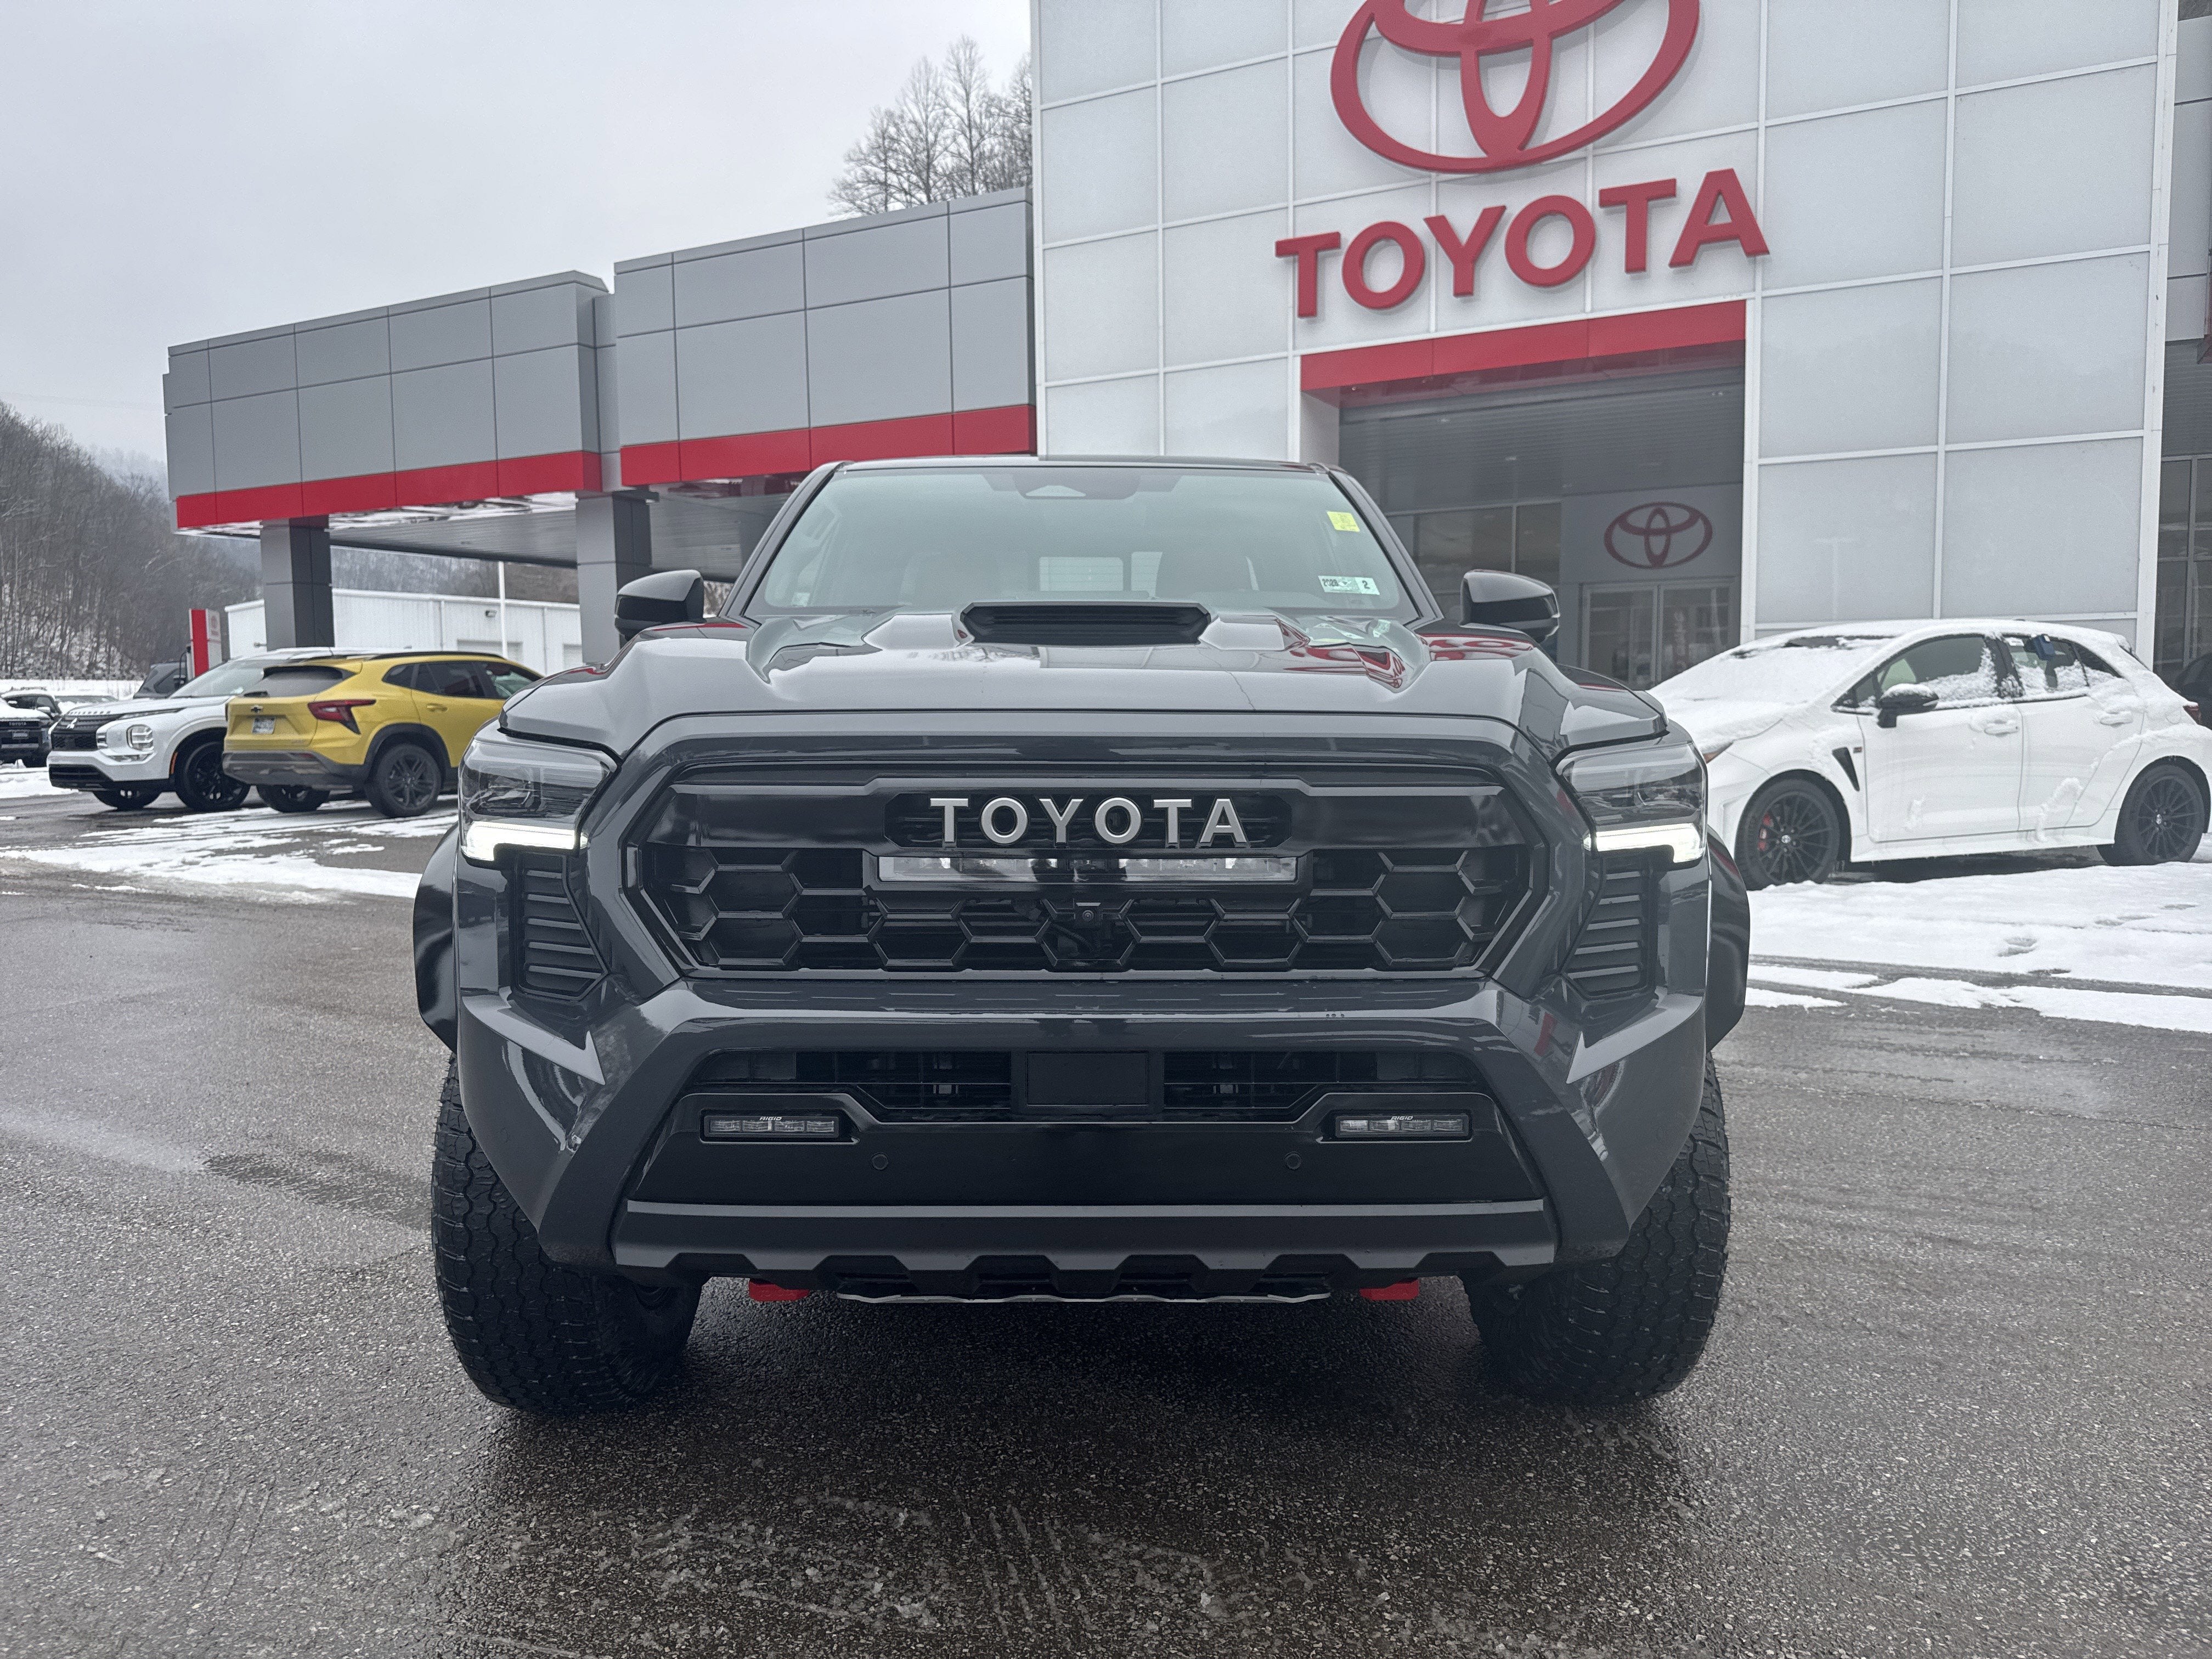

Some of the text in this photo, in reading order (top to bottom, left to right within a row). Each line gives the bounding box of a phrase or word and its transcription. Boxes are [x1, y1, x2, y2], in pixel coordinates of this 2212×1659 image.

[1275, 168, 1770, 319] TOYOTA
[1362, 580, 1370, 590] 2
[929, 797, 1248, 845] TOYOTA
